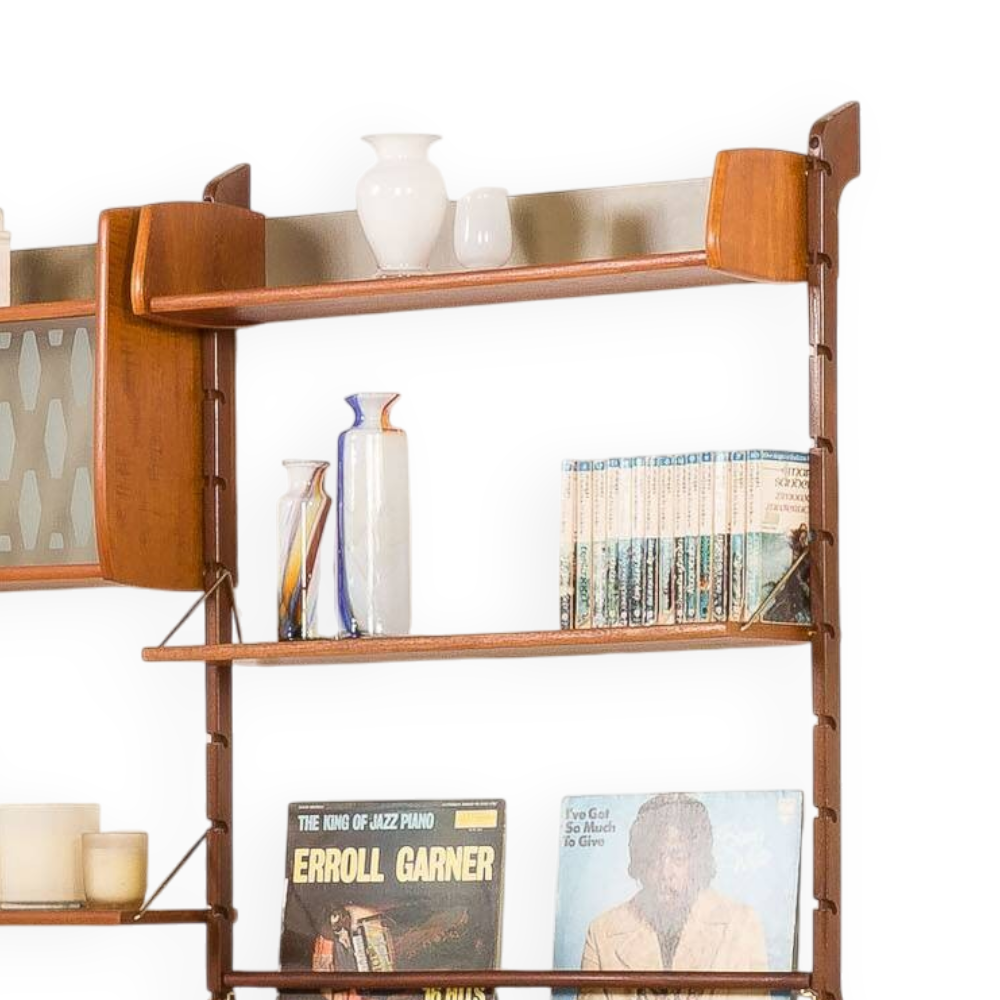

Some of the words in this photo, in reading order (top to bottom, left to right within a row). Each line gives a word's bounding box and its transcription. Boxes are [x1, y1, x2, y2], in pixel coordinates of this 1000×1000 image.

[588, 807, 610, 820] Got
[298, 815, 319, 831] THE
[323, 815, 350, 831] KING
[352, 814, 368, 831] OF
[369, 812, 399, 830] JAZZ
[400, 812, 435, 830] PIANO
[565, 821, 580, 833] So
[583, 820, 616, 833] Much
[564, 835, 576, 847] To
[579, 835, 605, 847] Give
[293, 846, 385, 883] ERROLL
[395, 845, 495, 882] GARNER
